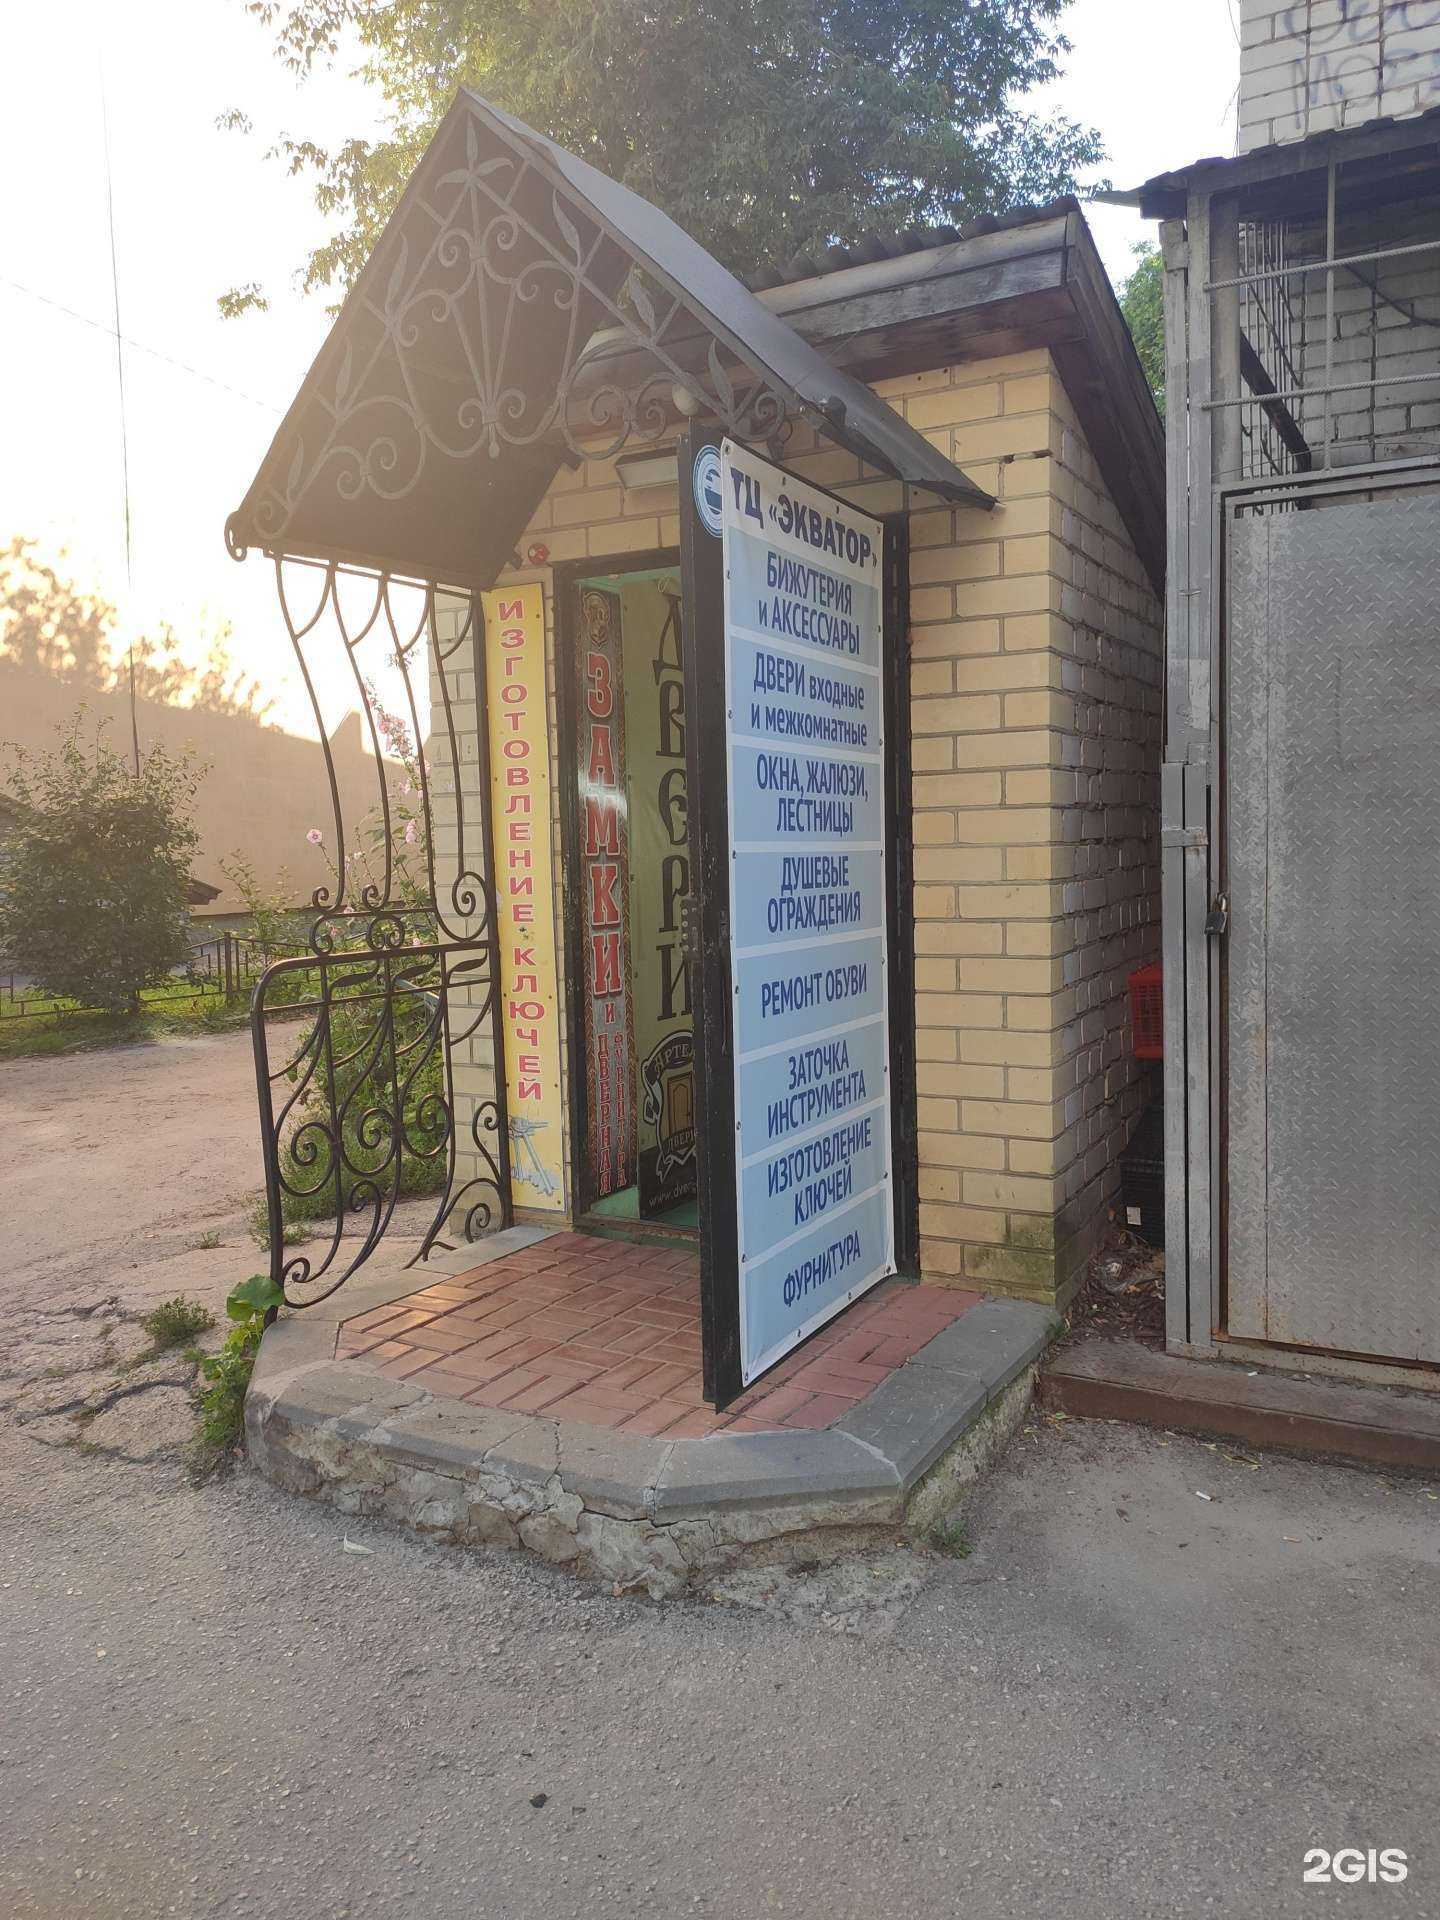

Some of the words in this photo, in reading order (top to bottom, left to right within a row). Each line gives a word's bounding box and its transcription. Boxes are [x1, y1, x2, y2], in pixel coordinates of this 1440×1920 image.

[730, 467, 765, 529] ТЦ
[768, 494, 877, 568] «ЭКВАТОР»
[767, 551, 852, 616] БИЖУТЕРИЯ
[771, 596, 860, 655] АКСЕССУАРЫ
[753, 652, 805, 697] ДВЕРИ
[809, 675, 865, 710] входные
[765, 706, 867, 746] межкомнатные
[498, 599, 534, 923] ИЗГОТОВЛЕНИЕ
[756, 754, 805, 797] ОКНА,
[806, 760, 868, 802] ЖАЛЮЗИ,
[584, 651, 623, 995] ЗАМКИ
[776, 797, 853, 837] ЛЕСТНИЦЫ
[781, 856, 849, 896] ДУШЕВЫЕ
[767, 891, 861, 933] ОГРАЖДЕНИЯ
[761, 972, 823, 1018] РЕМОНТ
[825, 963, 867, 1002] ОБУВИ
[509, 947, 546, 1100] КЛЮЧЕЙ
[788, 1040, 849, 1090] ЗАТОЧКА
[768, 1070, 867, 1139] ИНСТРУМЕНТА
[768, 1117, 871, 1198] ИЗГОТОВЛЕНИЕ
[794, 1158, 852, 1226] КЛЮЧЕЙ
[783, 1230, 861, 1308] ФУРНИТУРА
